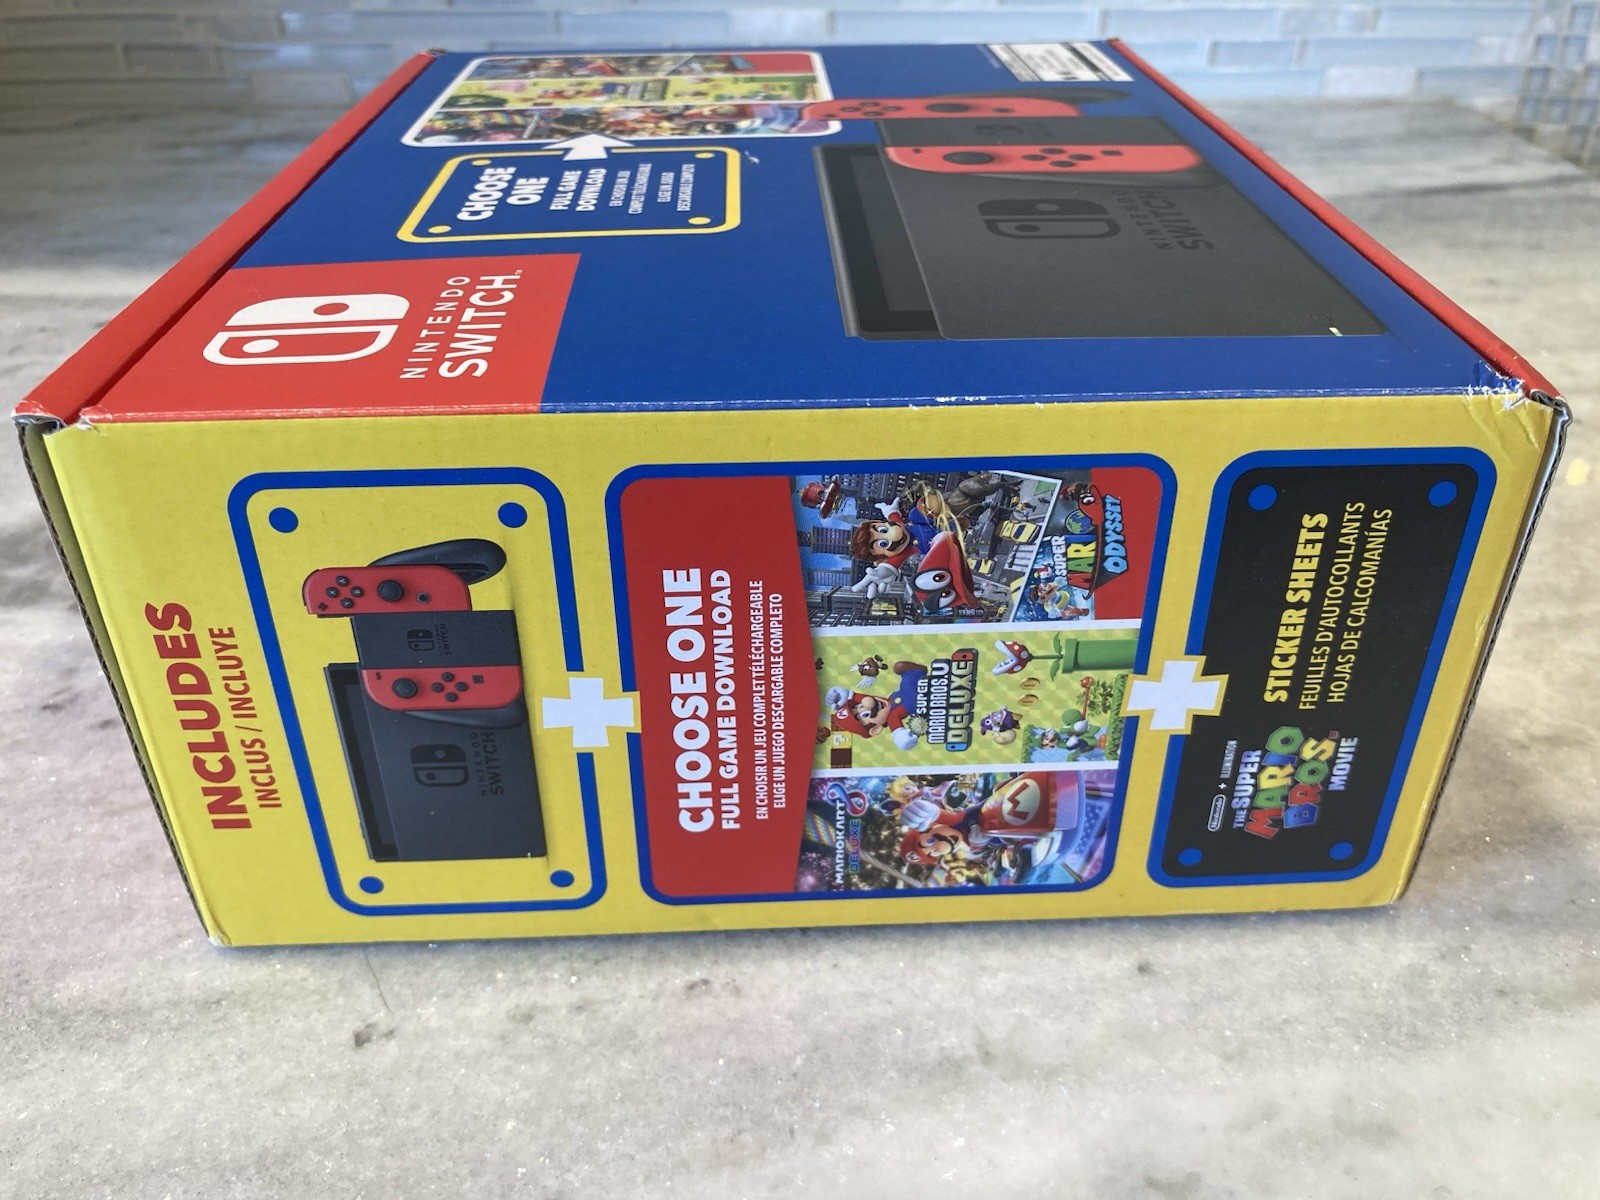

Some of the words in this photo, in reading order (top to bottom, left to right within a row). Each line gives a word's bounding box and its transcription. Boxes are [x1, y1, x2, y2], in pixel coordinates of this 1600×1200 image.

[457, 167, 517, 221] CHOOSE
[506, 177, 549, 205] ONE
[549, 191, 574, 210] FULL
[557, 170, 582, 191] GAME
[575, 168, 607, 211] DOWNLOAD
[1110, 190, 1174, 250] NINTENDO
[1132, 190, 1215, 250] SWITCH
[399, 276, 472, 379] NINTENDO
[438, 273, 521, 378] SWITCH
[1050, 535, 1067, 577] SUPER
[1102, 494, 1128, 574] ODYSSEY
[1347, 507, 1393, 631] CALCOMANÍAS
[662, 568, 706, 662] ONE
[748, 580, 765, 679] TÉLÉCHARGEABLE
[768, 593, 783, 654] COMPLETO
[1263, 605, 1308, 703] STICKER
[1286, 512, 1328, 604] SHEETS
[1299, 644, 1328, 710] FEUILLES
[1316, 501, 1365, 643] D'AUTOCOLLANTS
[710, 569, 736, 711] DOWNLOAD
[1341, 631, 1362, 657] DE
[208, 626, 258, 718] INCLUYE
[770, 655, 784, 730] DESCARGABLE
[916, 679, 928, 714] SUPER
[946, 661, 973, 743] DELUXE
[1327, 657, 1356, 703] HOJAS
[144, 602, 252, 829] INCLUDES
[752, 679, 765, 728] COMPLET
[928, 708, 947, 743] MARIO
[470, 731, 488, 796] NINTENDO
[480, 730, 504, 796] SWITCH
[670, 671, 715, 833] CHOOSE
[716, 715, 738, 779] GAME
[753, 729, 767, 748] JEU
[755, 749, 767, 764] UN
[771, 731, 785, 765] JUEGO
[1328, 737, 1359, 791] MOVIE
[239, 738, 283, 808] INCLUS
[755, 764, 768, 806] CHOISIR
[772, 767, 785, 781] UN
[773, 782, 786, 808] ELIGE
[825, 781, 868, 817] 8
[1210, 795, 1224, 829] Nintendo
[1220, 740, 1238, 778] ILLUMINATION
[1231, 749, 1262, 810] SUPER
[1244, 725, 1304, 840] MARIO
[720, 782, 741, 830] FULL
[756, 806, 769, 820] EN
[1232, 809, 1248, 829] THE
[848, 819, 861, 873] DELUXE
